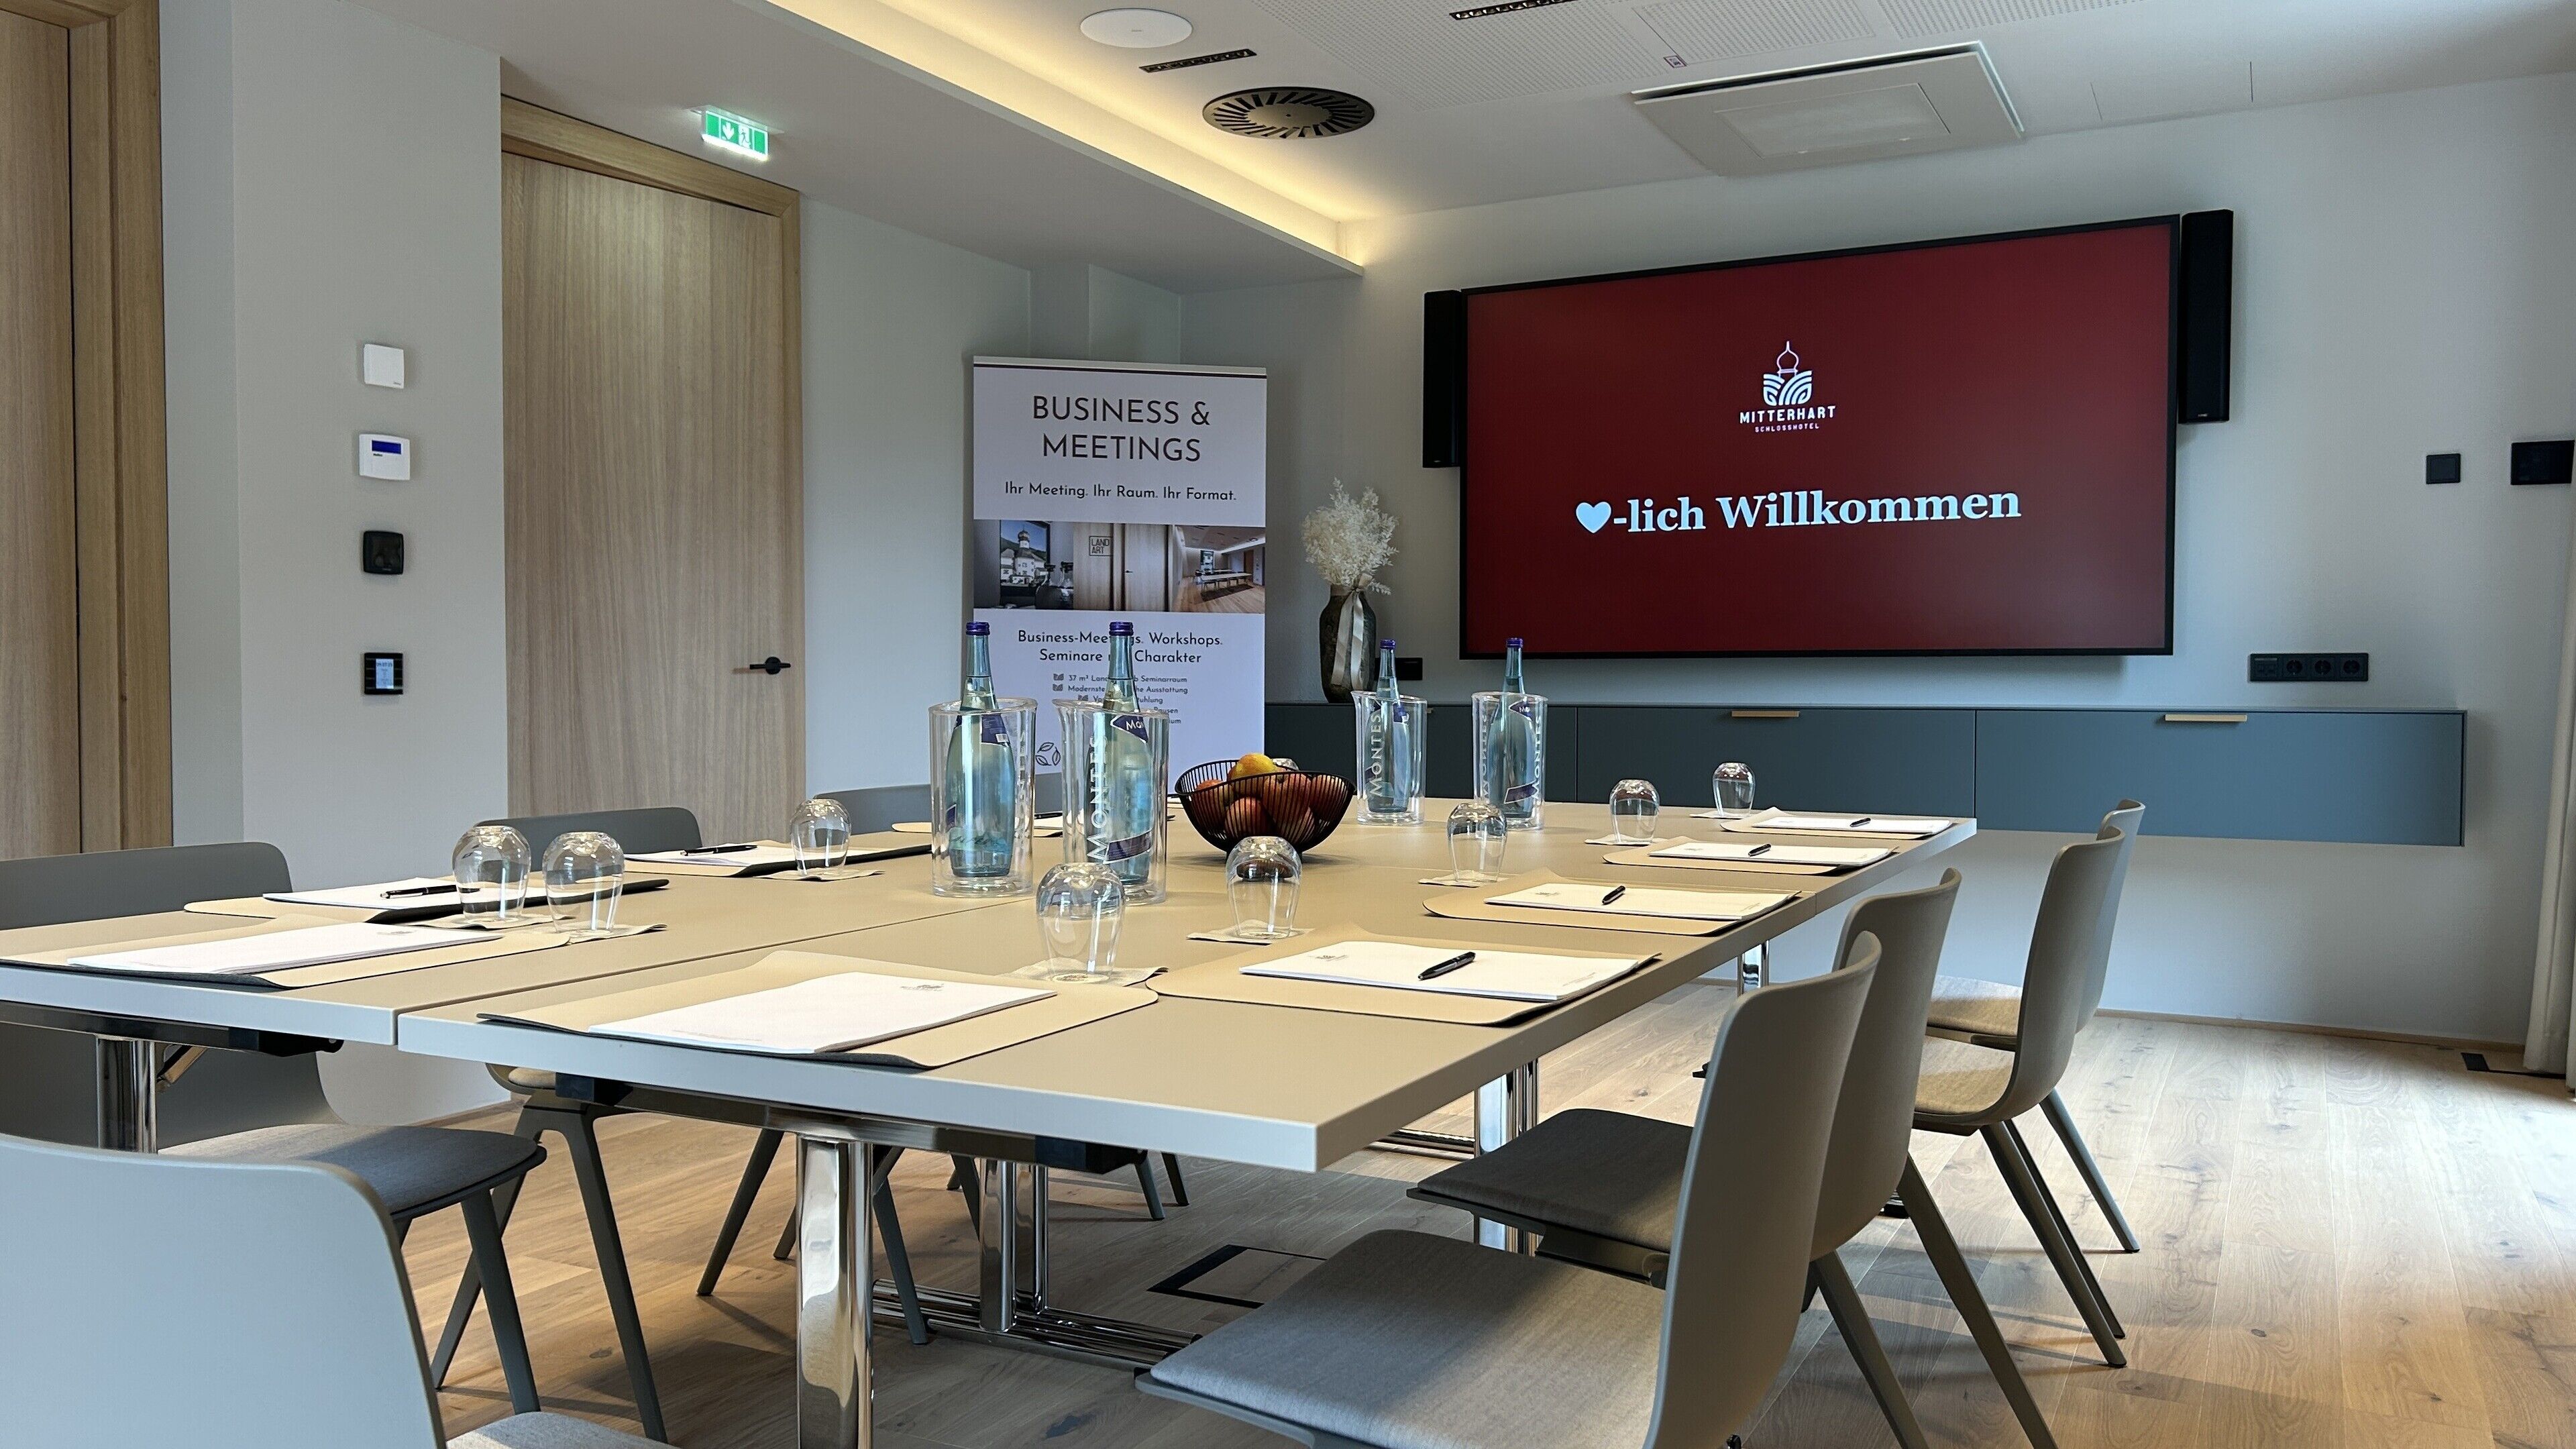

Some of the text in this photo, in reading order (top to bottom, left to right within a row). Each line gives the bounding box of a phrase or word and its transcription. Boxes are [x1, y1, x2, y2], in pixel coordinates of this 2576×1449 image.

[1033, 395, 1210, 426] BUSINESS &
[1739, 405, 1836, 424] MITTERHART
[1754, 423, 1820, 433] SCHLOSSHOTEL
[1042, 433, 1201, 462] MEETINGS
[1006, 480, 1237, 502] Ihr Meeting. Ihr Raum. Ihr Format.
[1715, 490, 2022, 529] Willkommen
[1091, 538, 1110, 547] LAND
[1148, 631, 1224, 648] Workshops.
[1039, 648, 1104, 661] Seminare
[1134, 648, 1201, 663] Charakter
[1068, 684, 1106, 692] Modernste
[1146, 686, 1189, 694] Ausstattung
[1140, 675, 1188, 683] Seminarraum
[1368, 714, 1383, 800] MONTES
[1531, 715, 1542, 800] MONTES
[1087, 735, 1110, 863] MONTES
